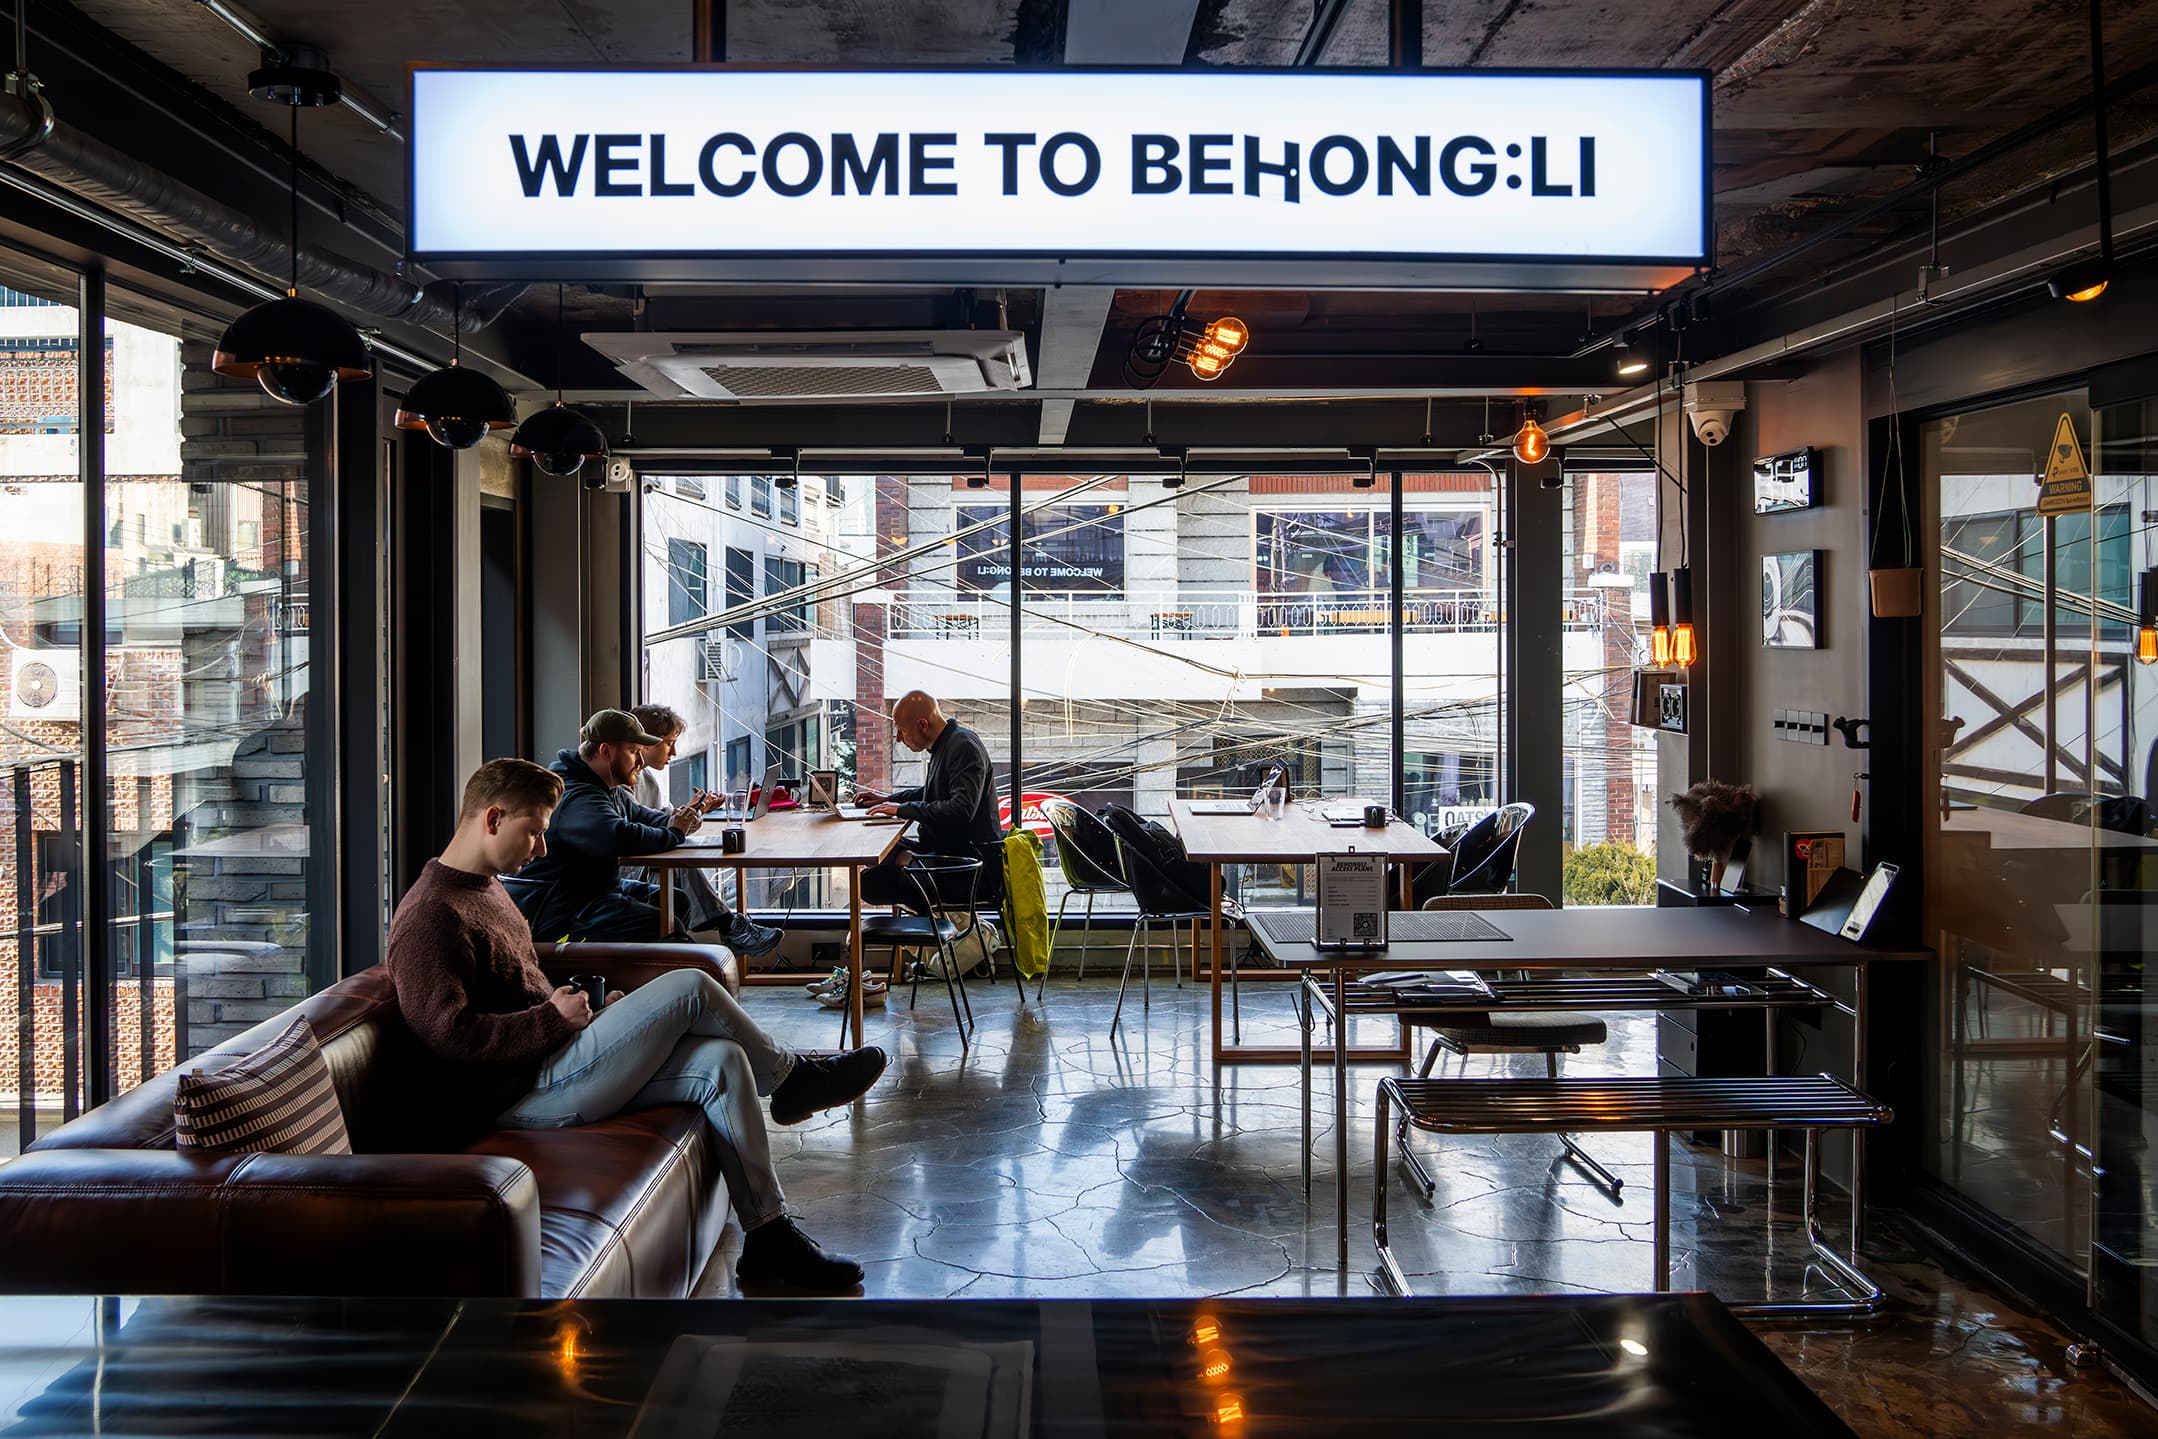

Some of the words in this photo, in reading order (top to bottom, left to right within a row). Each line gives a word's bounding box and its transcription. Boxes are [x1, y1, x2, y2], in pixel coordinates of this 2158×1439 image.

[509, 132, 958, 198] WELCOME
[984, 132, 1101, 197] TO
[2048, 481, 2083, 495] WARNING
[1445, 810, 1489, 827] OATS
